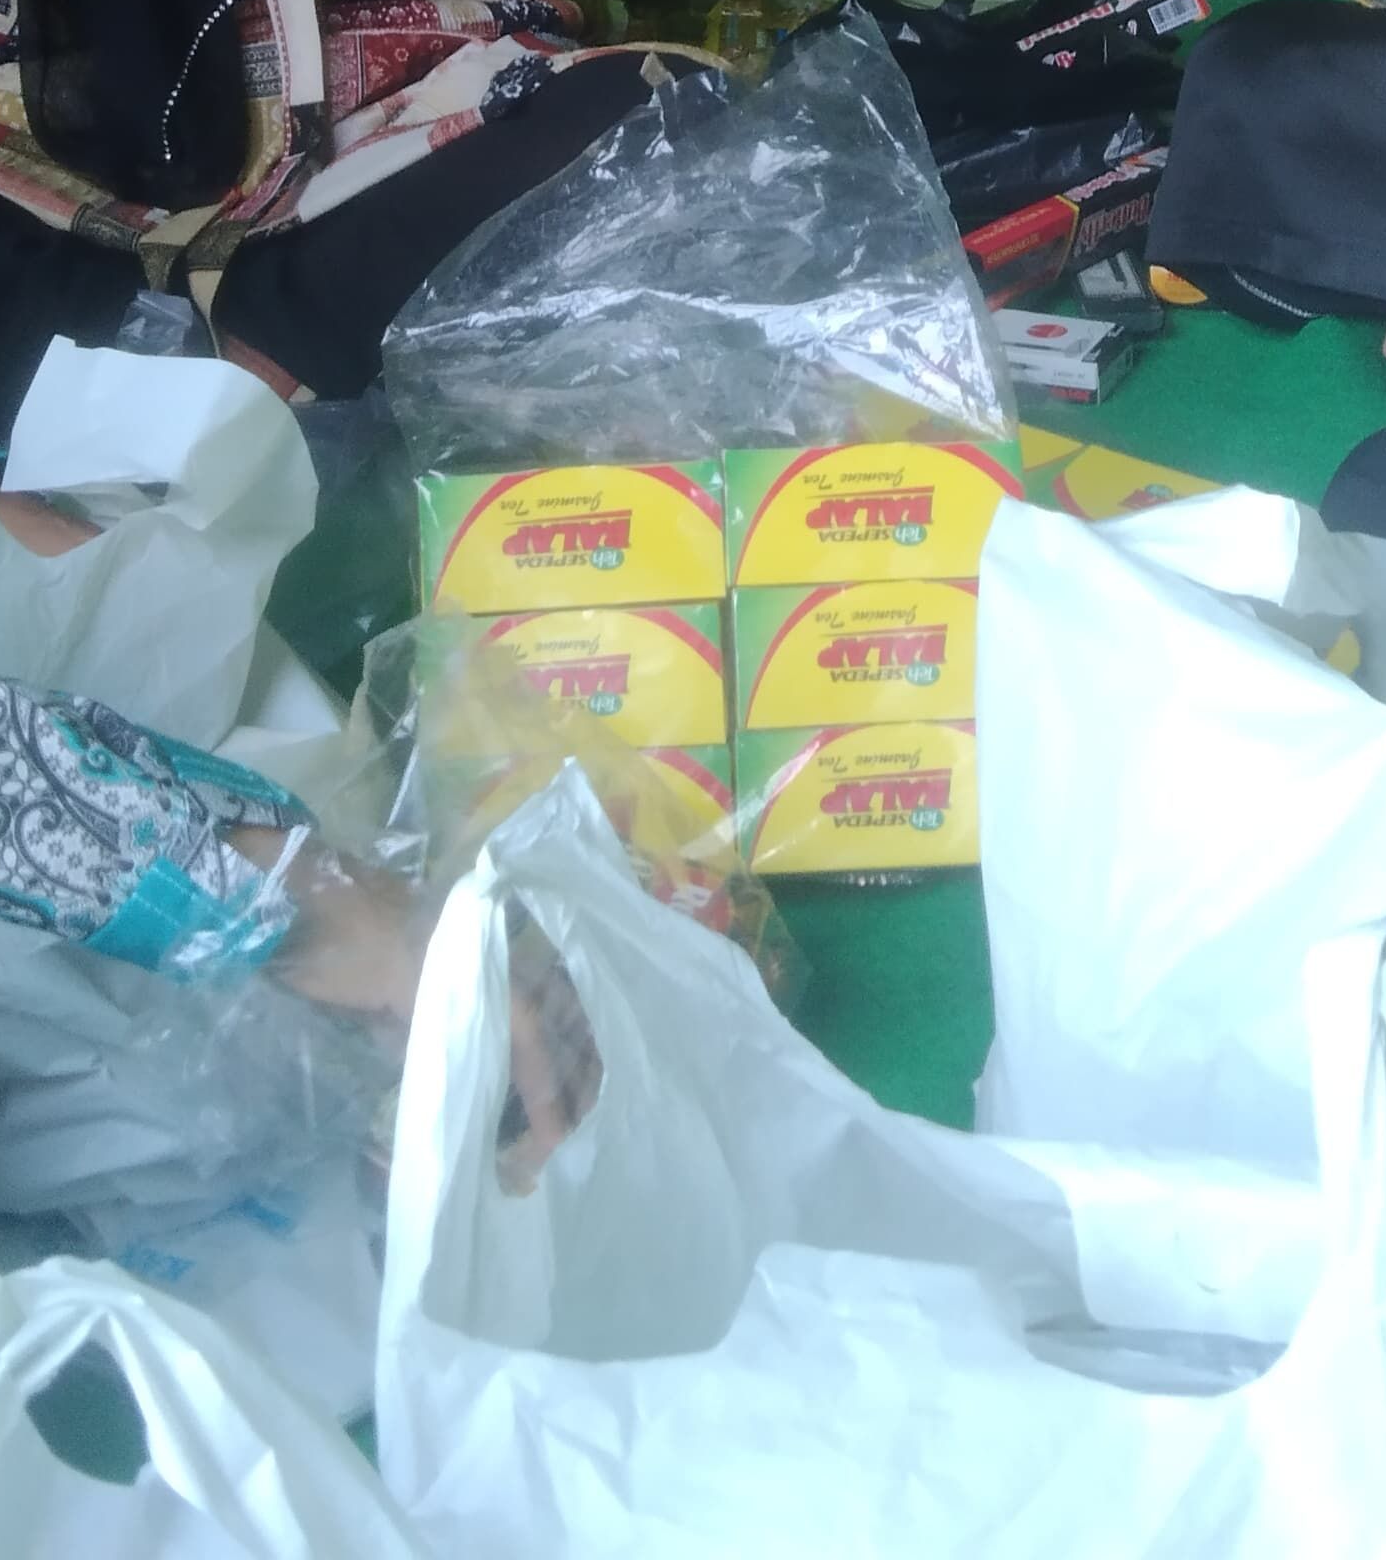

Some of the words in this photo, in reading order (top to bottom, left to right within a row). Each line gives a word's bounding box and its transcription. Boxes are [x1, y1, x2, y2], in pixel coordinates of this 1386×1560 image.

[804, 494, 934, 530] BALAP
[502, 519, 632, 556] BALAP
[818, 529, 893, 543] SEPEDA
[894, 526, 925, 544] Teh
[514, 554, 591, 569] SEPEDA
[591, 549, 623, 568] Teh
[816, 634, 948, 670] BALAP
[829, 668, 904, 683] SEPEDA
[906, 666, 938, 684] Teh
[589, 695, 621, 714] Teh
[819, 779, 952, 816] BALAP
[832, 814, 908, 828] SEPEDA
[911, 810, 943, 830] Teh
